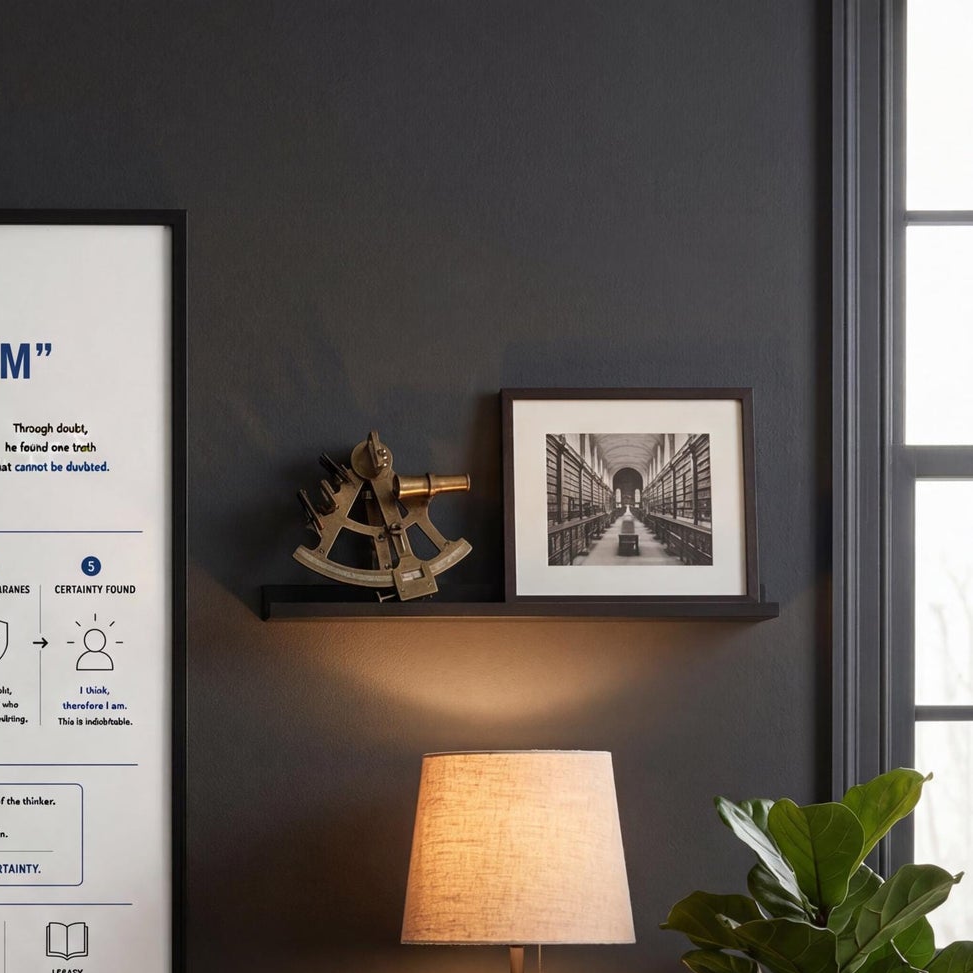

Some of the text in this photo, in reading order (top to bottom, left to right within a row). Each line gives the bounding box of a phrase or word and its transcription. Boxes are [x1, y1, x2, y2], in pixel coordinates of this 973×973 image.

[4, 441, 18, 453] he
[50, 444, 70, 453] one
[14, 462, 49, 472] cannot
[50, 460, 64, 472] be
[54, 584, 136, 595] CERTAINTY FOUND
[1, 700, 19, 709] who
[75, 716, 84, 726] is
